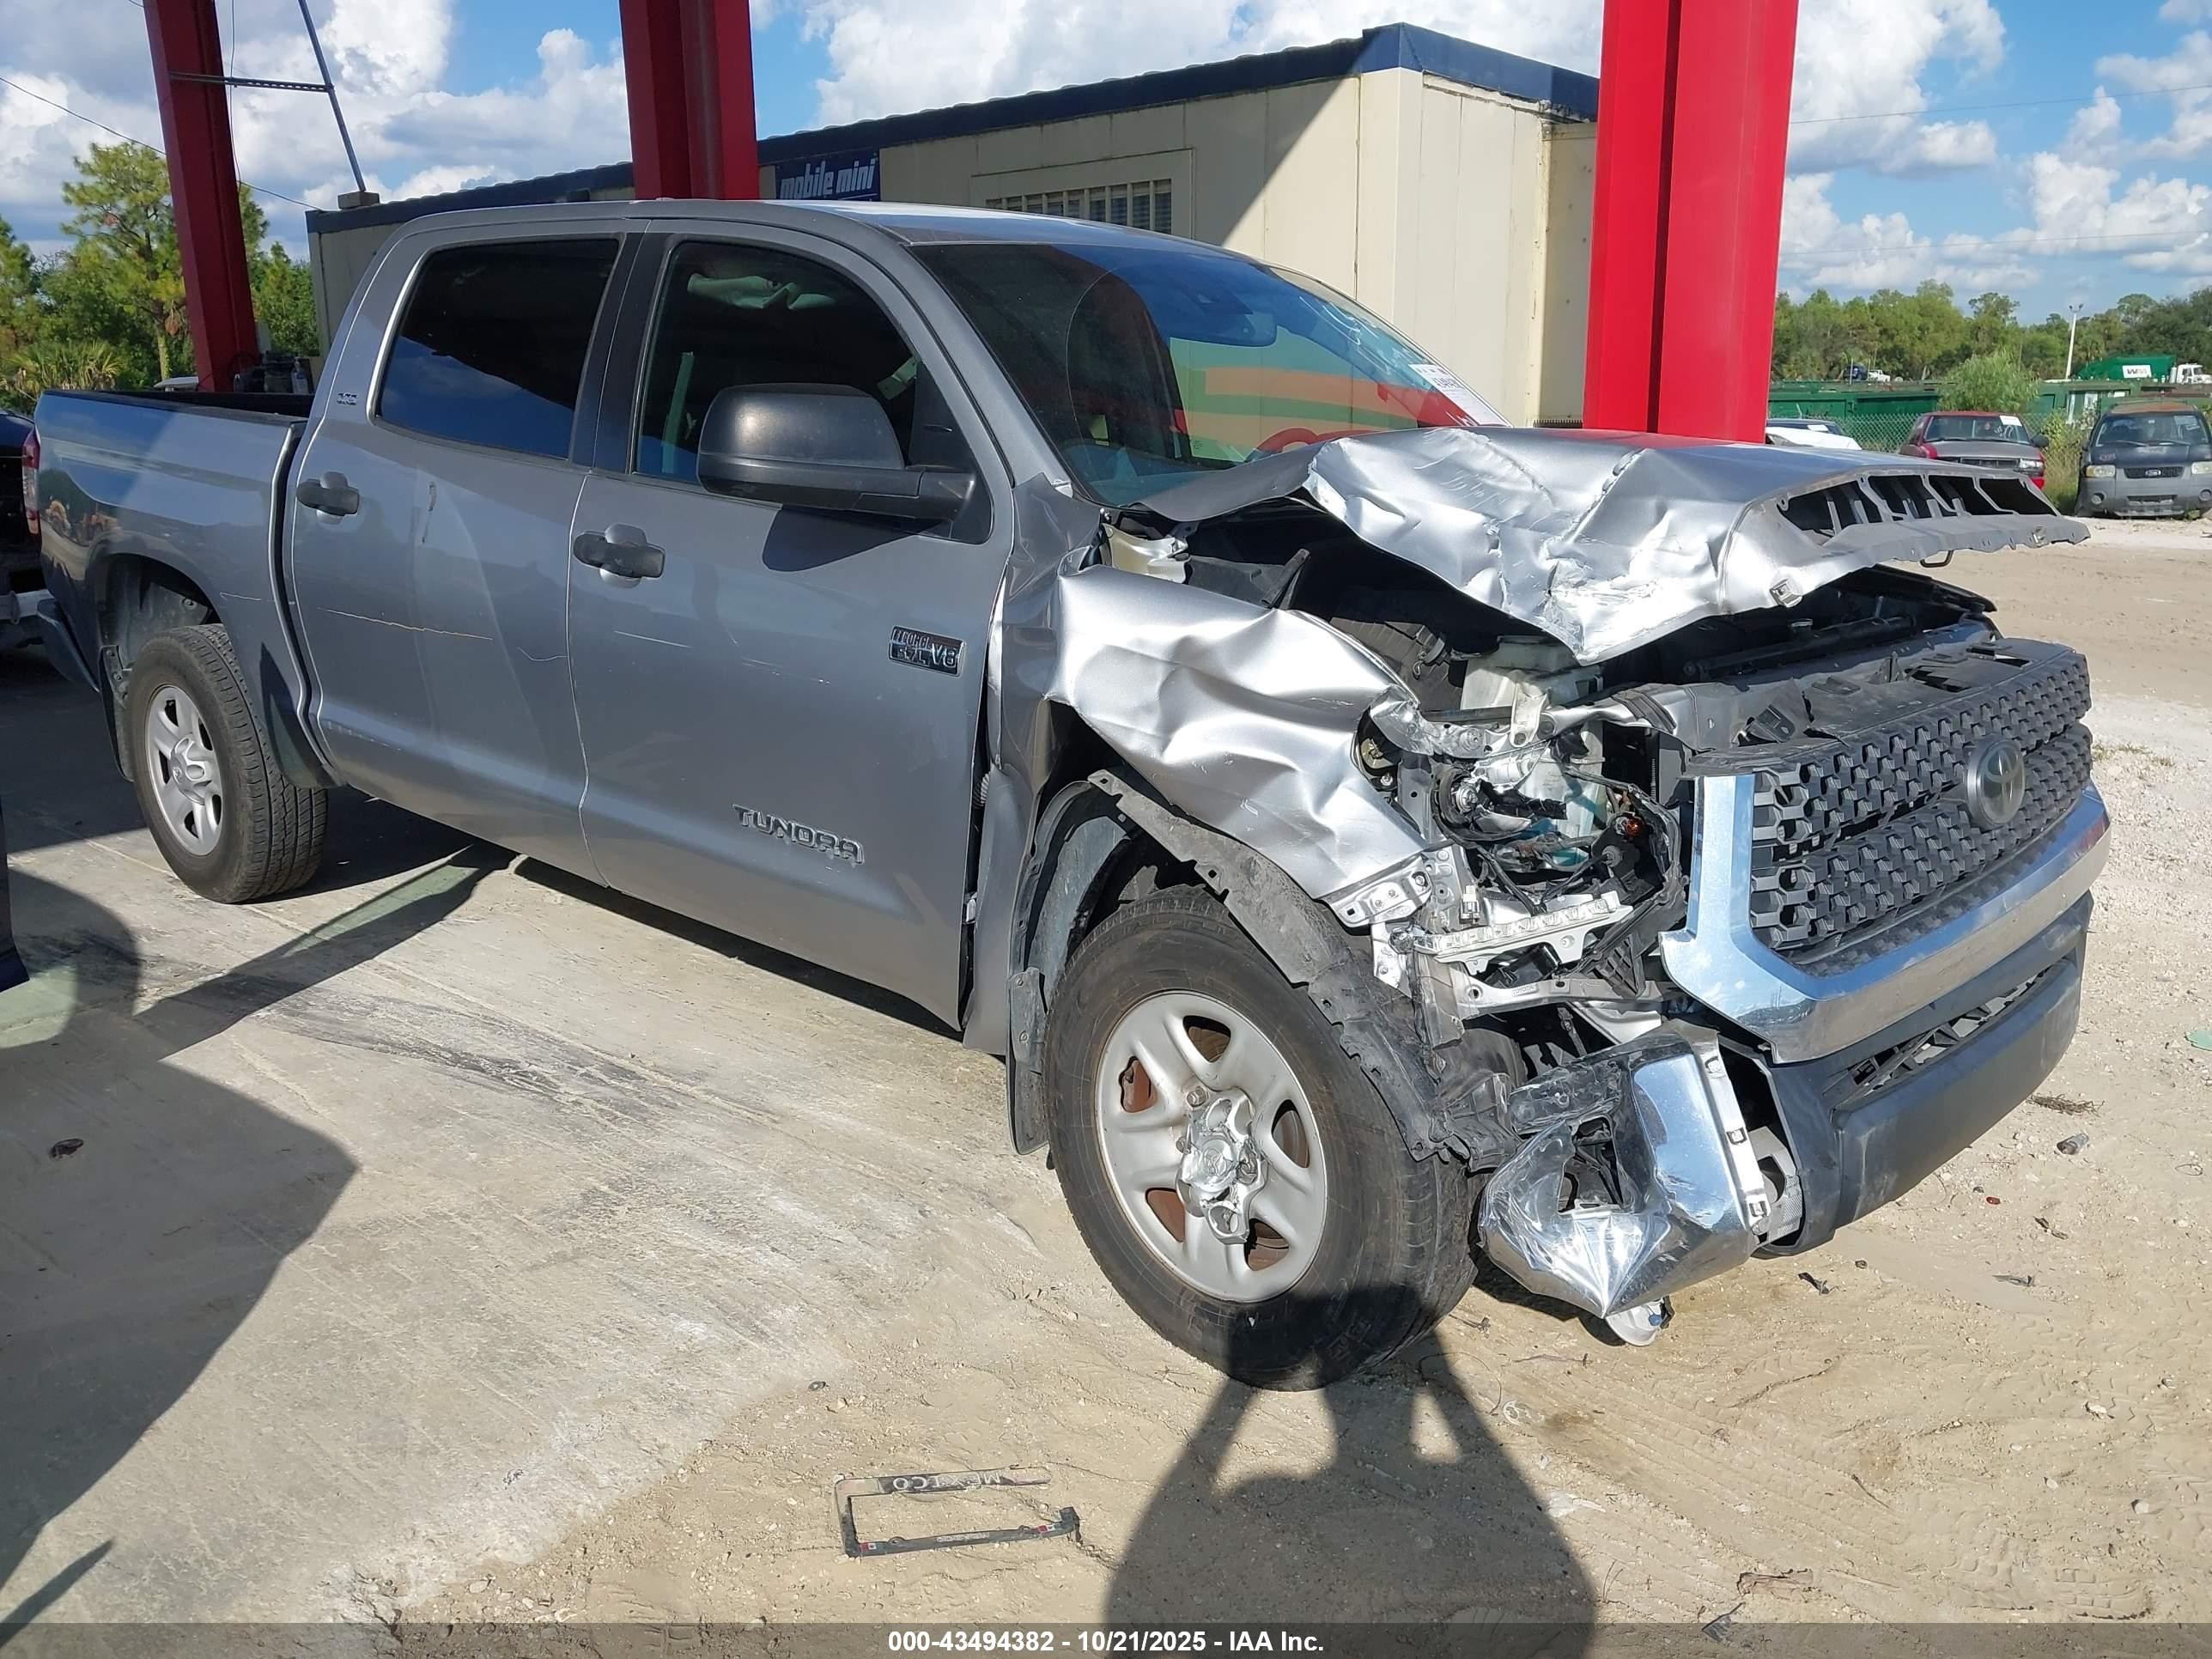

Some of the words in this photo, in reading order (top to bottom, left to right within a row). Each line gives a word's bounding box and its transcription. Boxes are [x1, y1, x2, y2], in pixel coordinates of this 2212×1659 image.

[781, 161, 834, 198] mobile
[836, 158, 875, 192] mini
[732, 804, 865, 864] TUNDRA
[893, 1472, 1001, 1490] MEXICO
